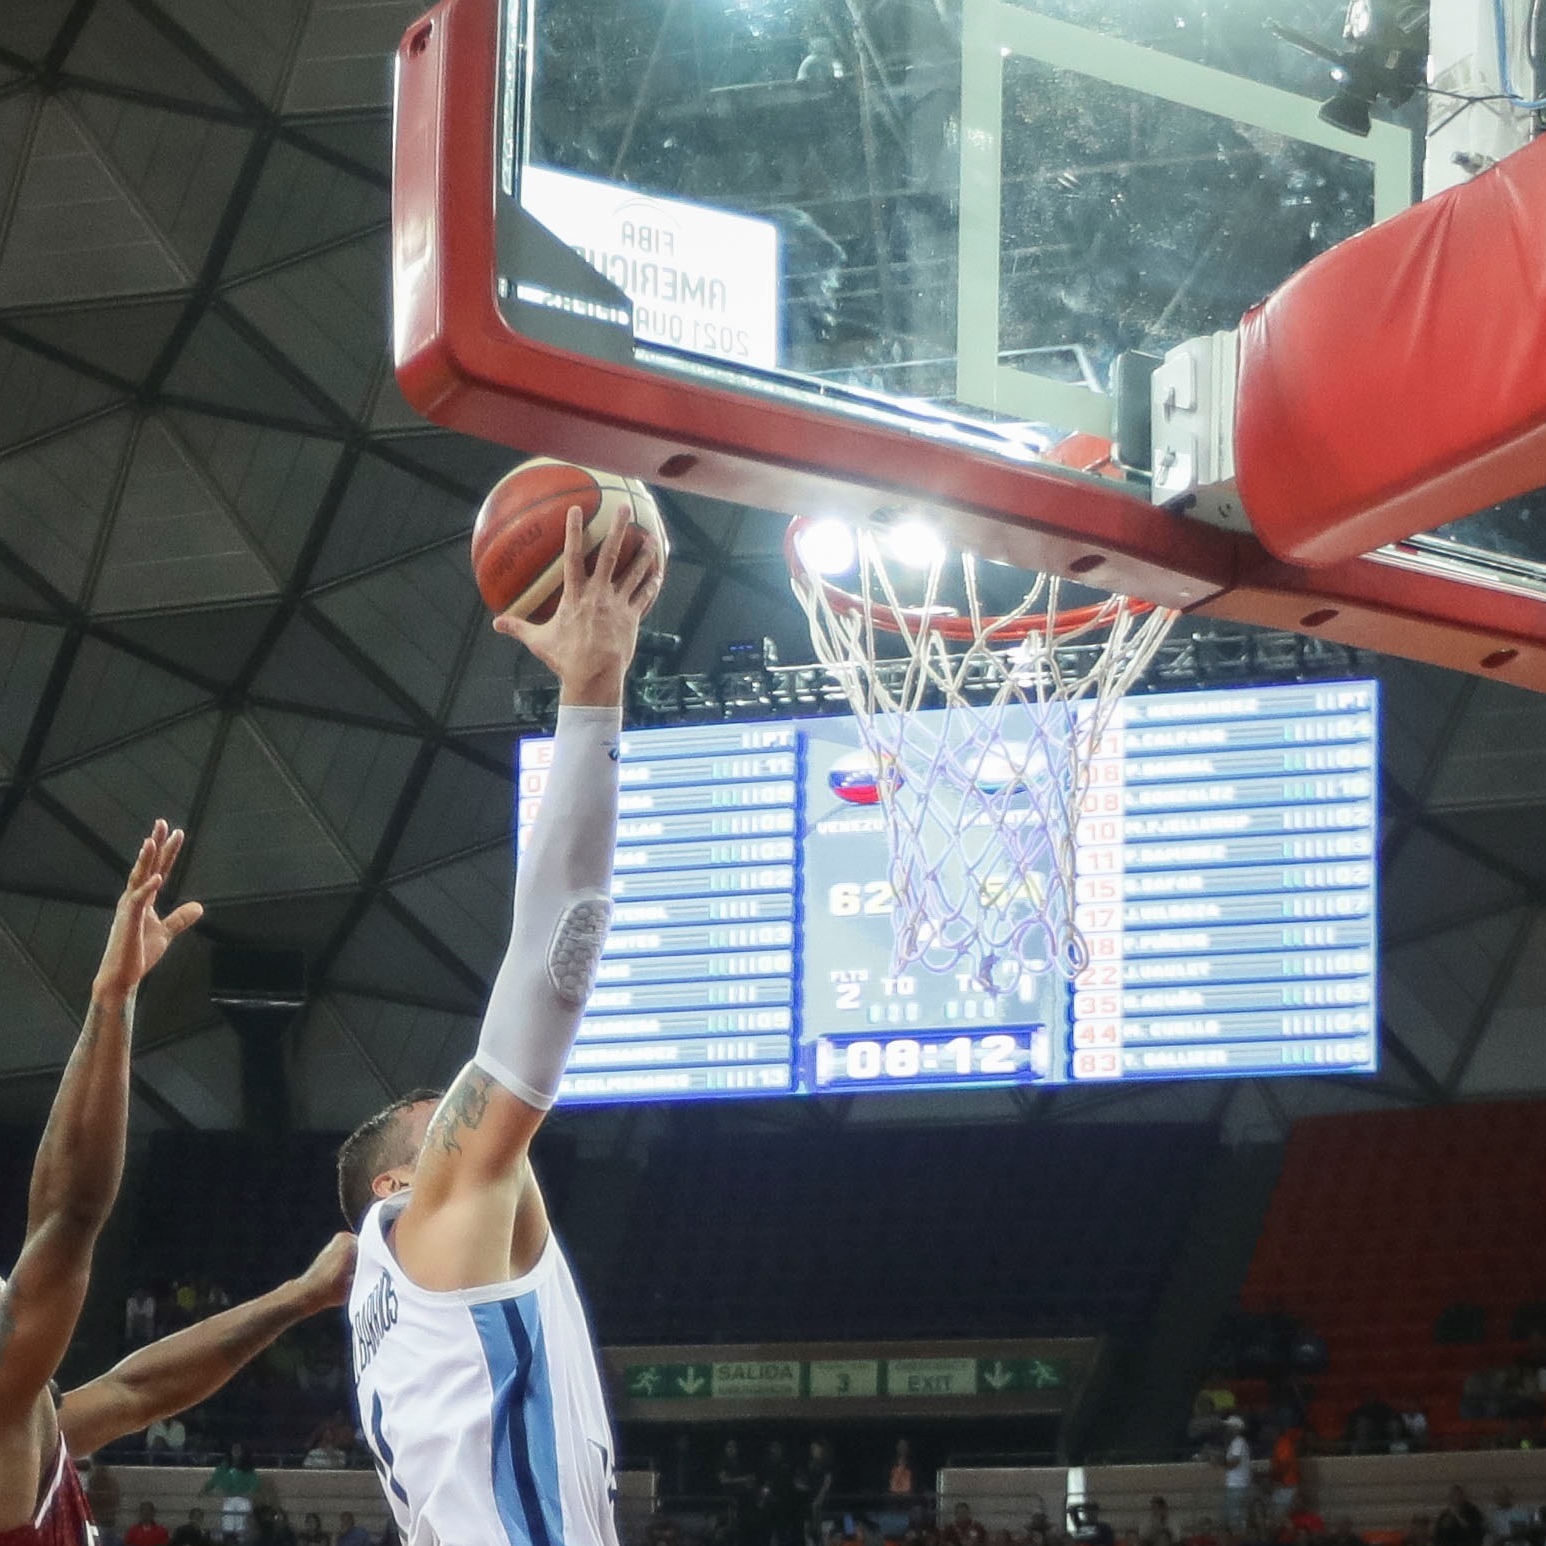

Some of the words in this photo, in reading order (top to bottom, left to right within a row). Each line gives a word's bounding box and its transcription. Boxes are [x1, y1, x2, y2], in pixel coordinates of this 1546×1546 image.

[1338, 692, 1368, 709] PT
[763, 731, 790, 746] PT
[1086, 821, 1116, 841] 10
[1086, 851, 1115, 870] 11
[829, 881, 893, 917] 62
[1083, 882, 1116, 898] 15
[1083, 909, 1115, 927] 17
[1080, 966, 1118, 987] 22
[835, 983, 861, 1010] 2
[881, 976, 915, 996] TO
[1080, 998, 1117, 1015] 35
[1079, 1025, 1117, 1044] 44
[846, 1034, 1016, 1080] 08:12
[1079, 1054, 1117, 1074] 83
[718, 1364, 794, 1383] SALIDA
